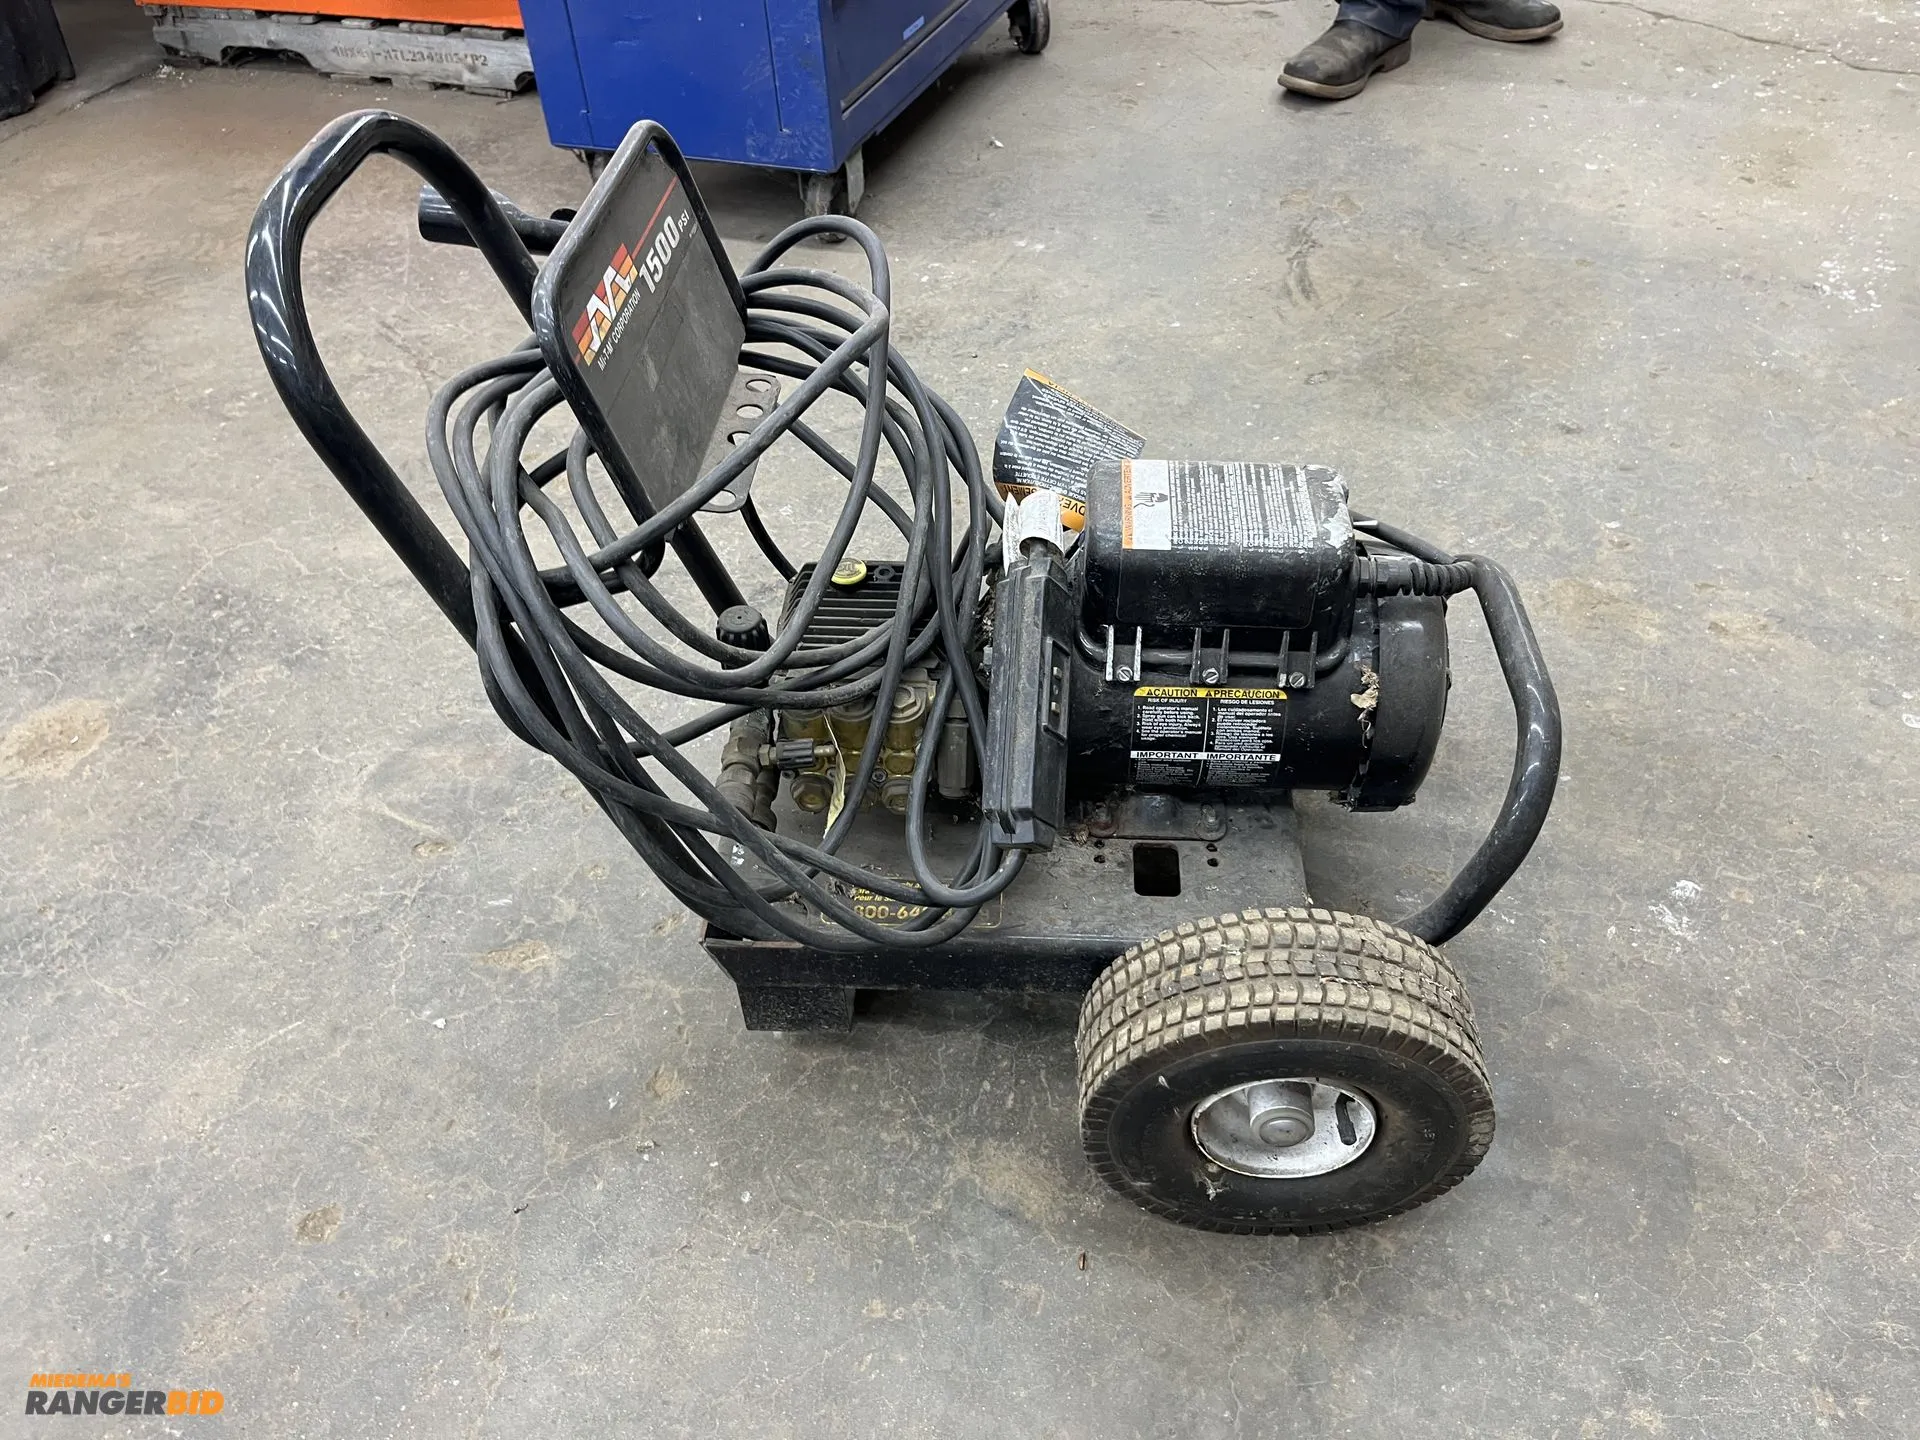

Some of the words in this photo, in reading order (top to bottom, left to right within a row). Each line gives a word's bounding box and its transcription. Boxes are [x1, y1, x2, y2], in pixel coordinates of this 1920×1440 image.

[639, 216, 680, 293] 1500
[677, 209, 690, 232] PSI
[612, 289, 641, 343] CORPORATION
